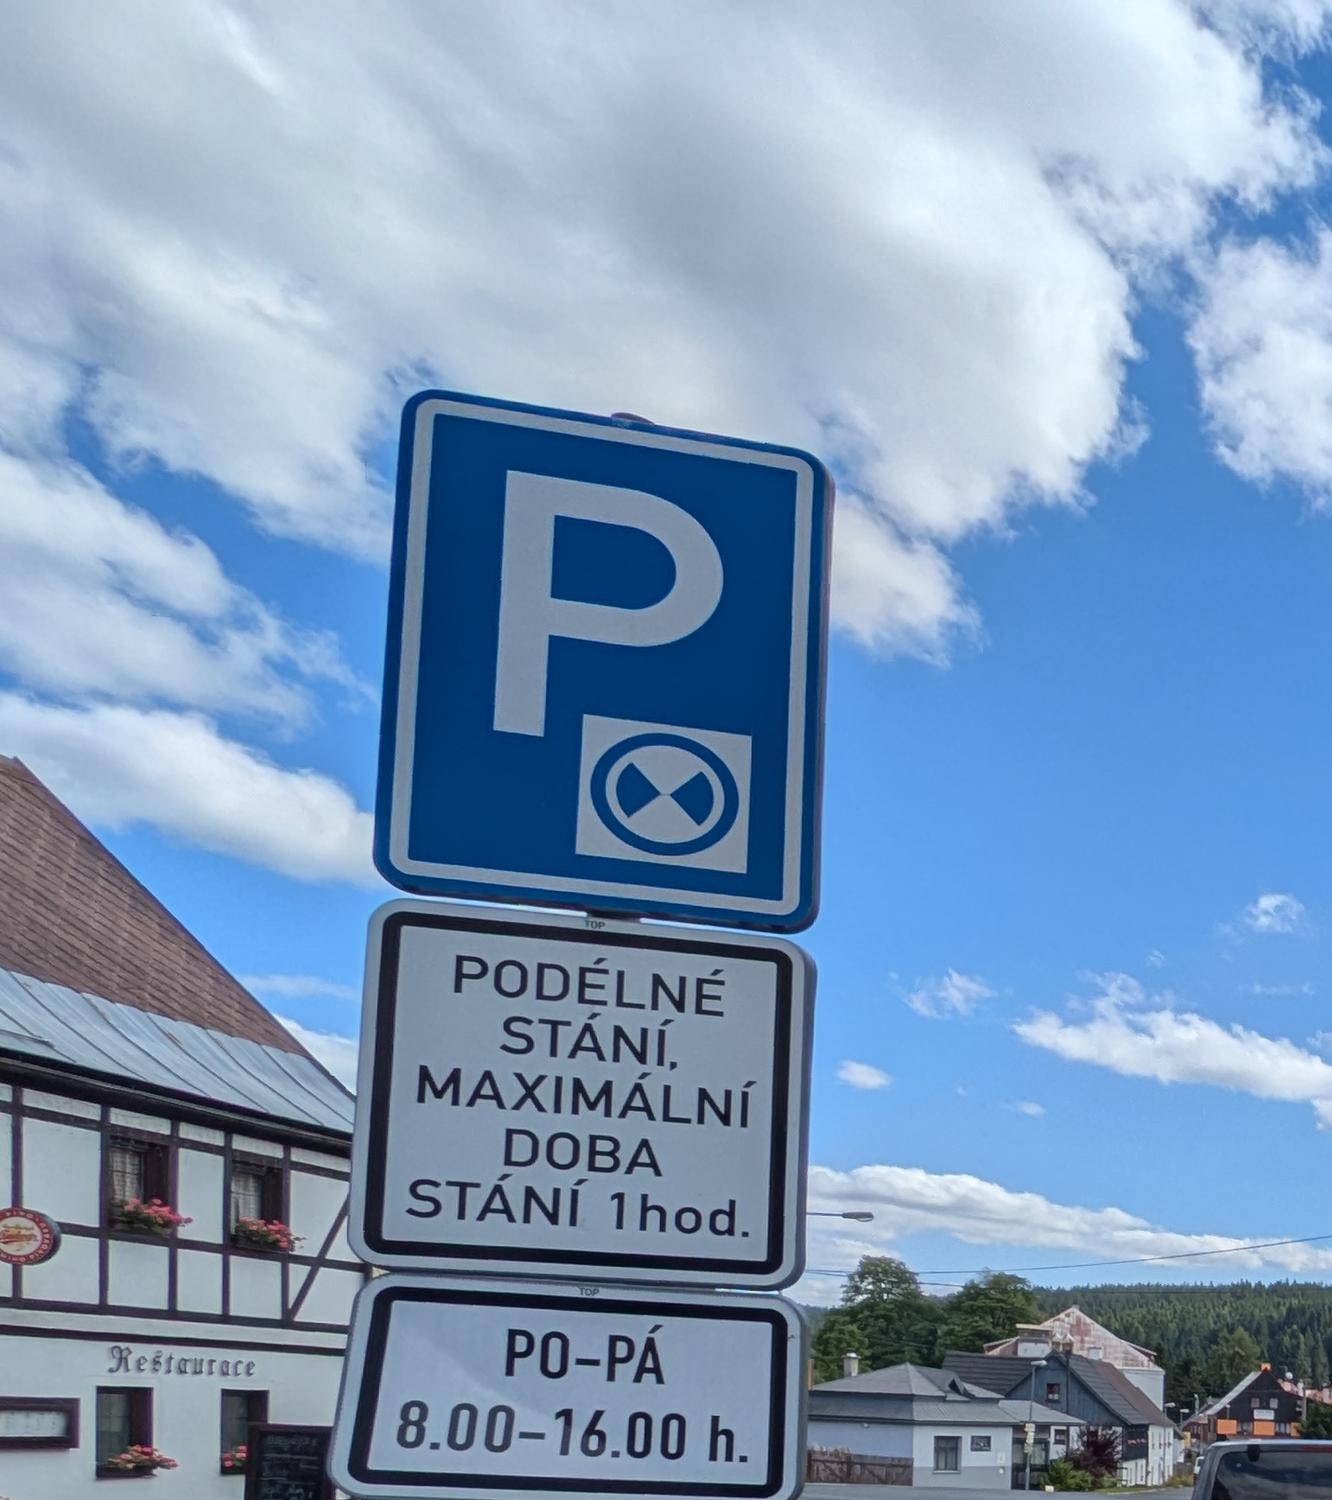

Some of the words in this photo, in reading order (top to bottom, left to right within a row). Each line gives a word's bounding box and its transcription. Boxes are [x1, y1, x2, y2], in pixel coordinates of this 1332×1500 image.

[493, 470, 724, 737] P
[584, 920, 606, 929] TOP
[453, 954, 726, 1017] PODÉLNÉ
[500, 1013, 679, 1070] STÁNÍ,
[416, 1065, 756, 1128] MAXIMÁLNÍ
[504, 1128, 662, 1177] DOBA
[406, 1174, 588, 1228] STÁNÍ
[580, 1288, 600, 1296] TOP
[708, 1413, 748, 1463] h.
